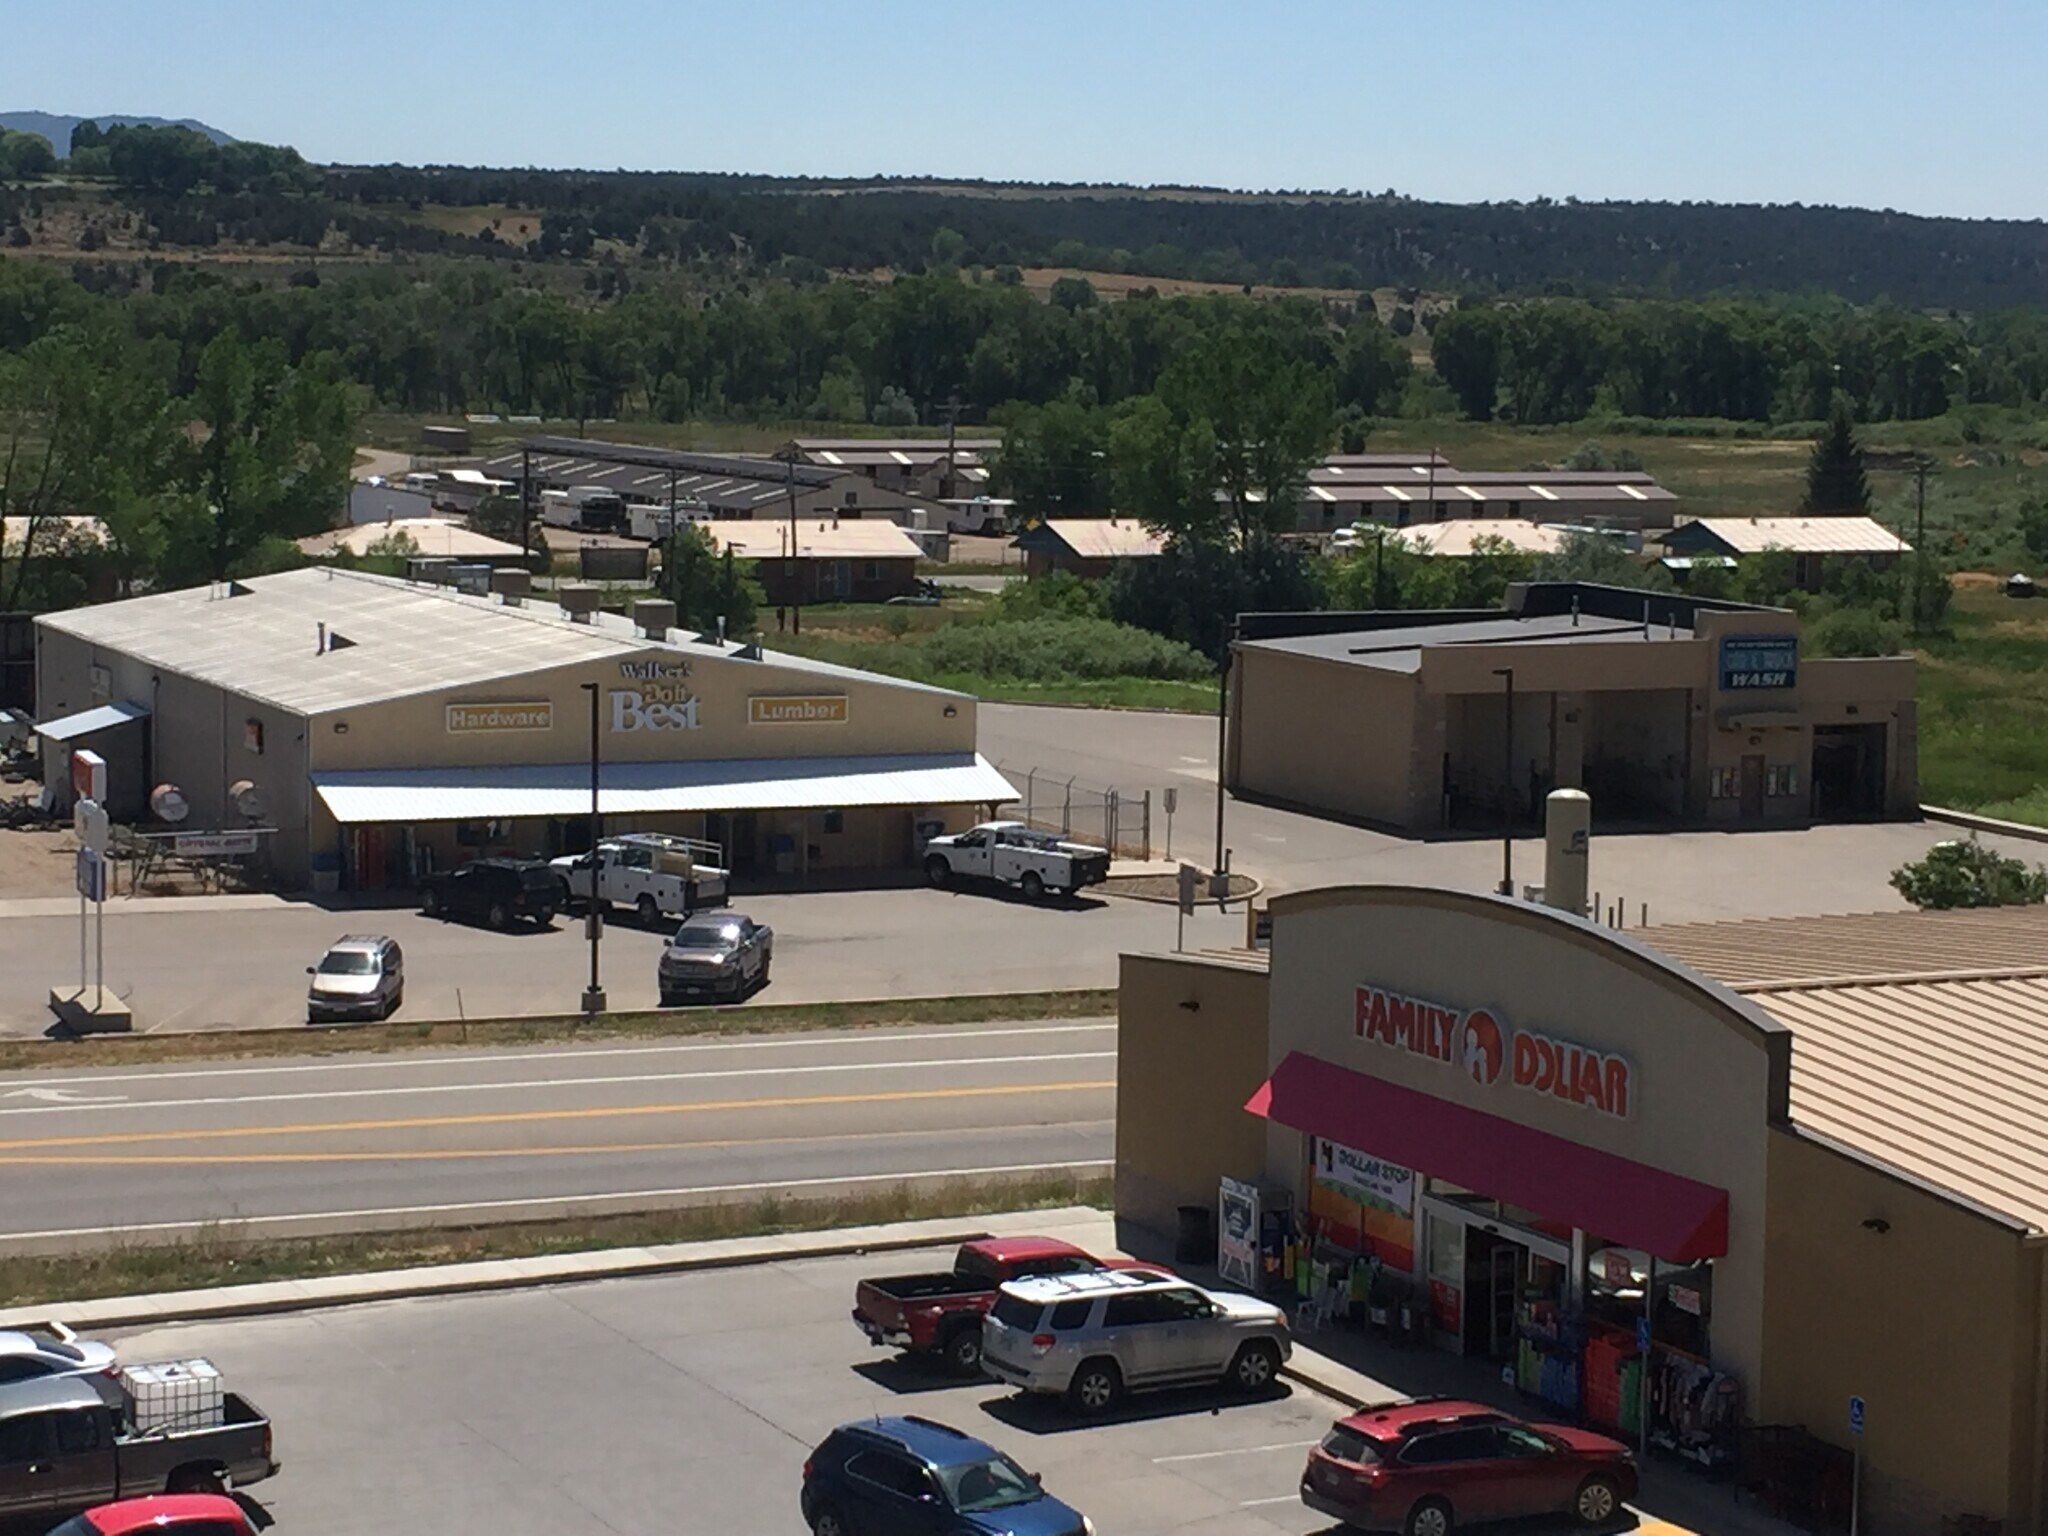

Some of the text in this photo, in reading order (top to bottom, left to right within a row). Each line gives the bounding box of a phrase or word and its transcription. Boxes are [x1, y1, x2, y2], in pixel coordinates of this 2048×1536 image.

[621, 661, 692, 679] Walker's
[1732, 672, 1787, 687] WASH
[451, 710, 549, 728] Hardware
[608, 690, 702, 732] Best
[759, 701, 839, 719] Lumber
[1355, 985, 1629, 1120] FAMILY DOLLAR
